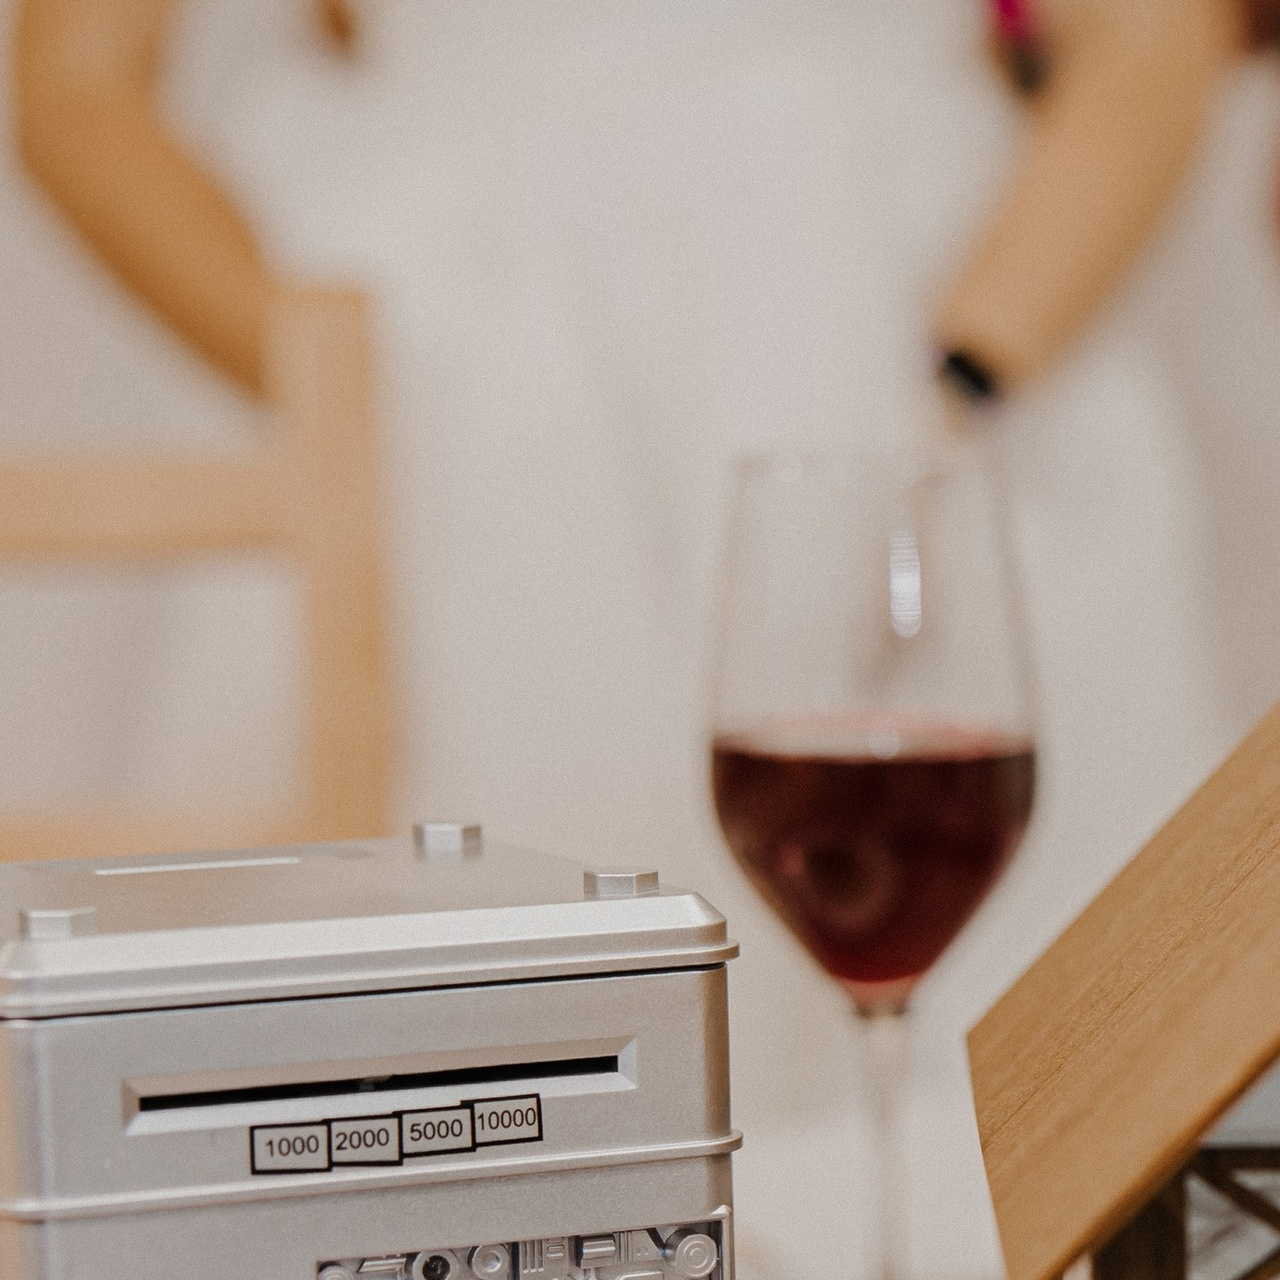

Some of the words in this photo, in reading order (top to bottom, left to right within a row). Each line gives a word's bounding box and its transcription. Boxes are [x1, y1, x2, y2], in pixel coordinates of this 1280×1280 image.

[266, 1134, 319, 1157] 1000
[335, 1128, 390, 1151] 2000
[410, 1119, 463, 1142] 5000
[476, 1107, 537, 1131] 10000
